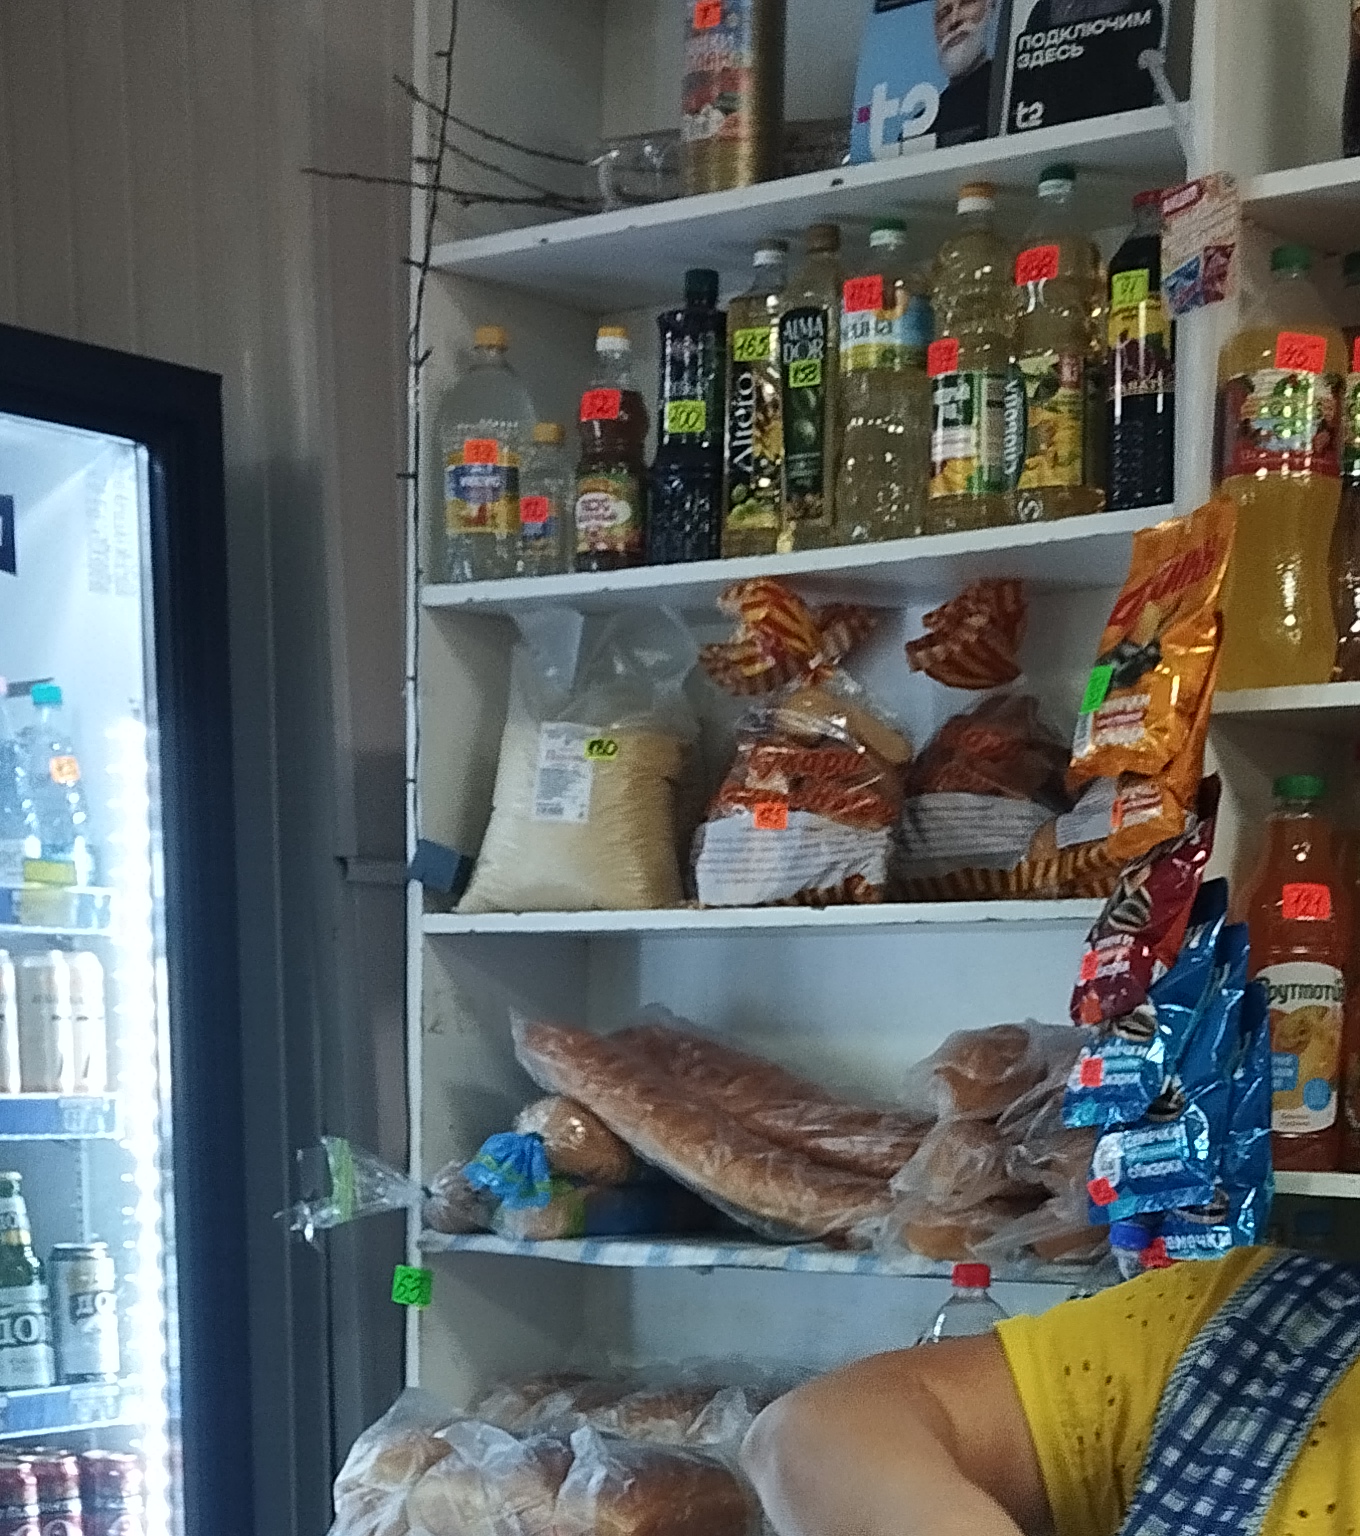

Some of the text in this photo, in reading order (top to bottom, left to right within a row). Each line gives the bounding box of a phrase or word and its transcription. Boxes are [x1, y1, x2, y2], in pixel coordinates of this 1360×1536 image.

[1018, 9, 1152, 51] ПОДКЛЮЧИМ
[1016, 44, 1084, 71] ЗДЕСЬ
[1015, 100, 1045, 129] t2
[729, 370, 755, 474] Altero
